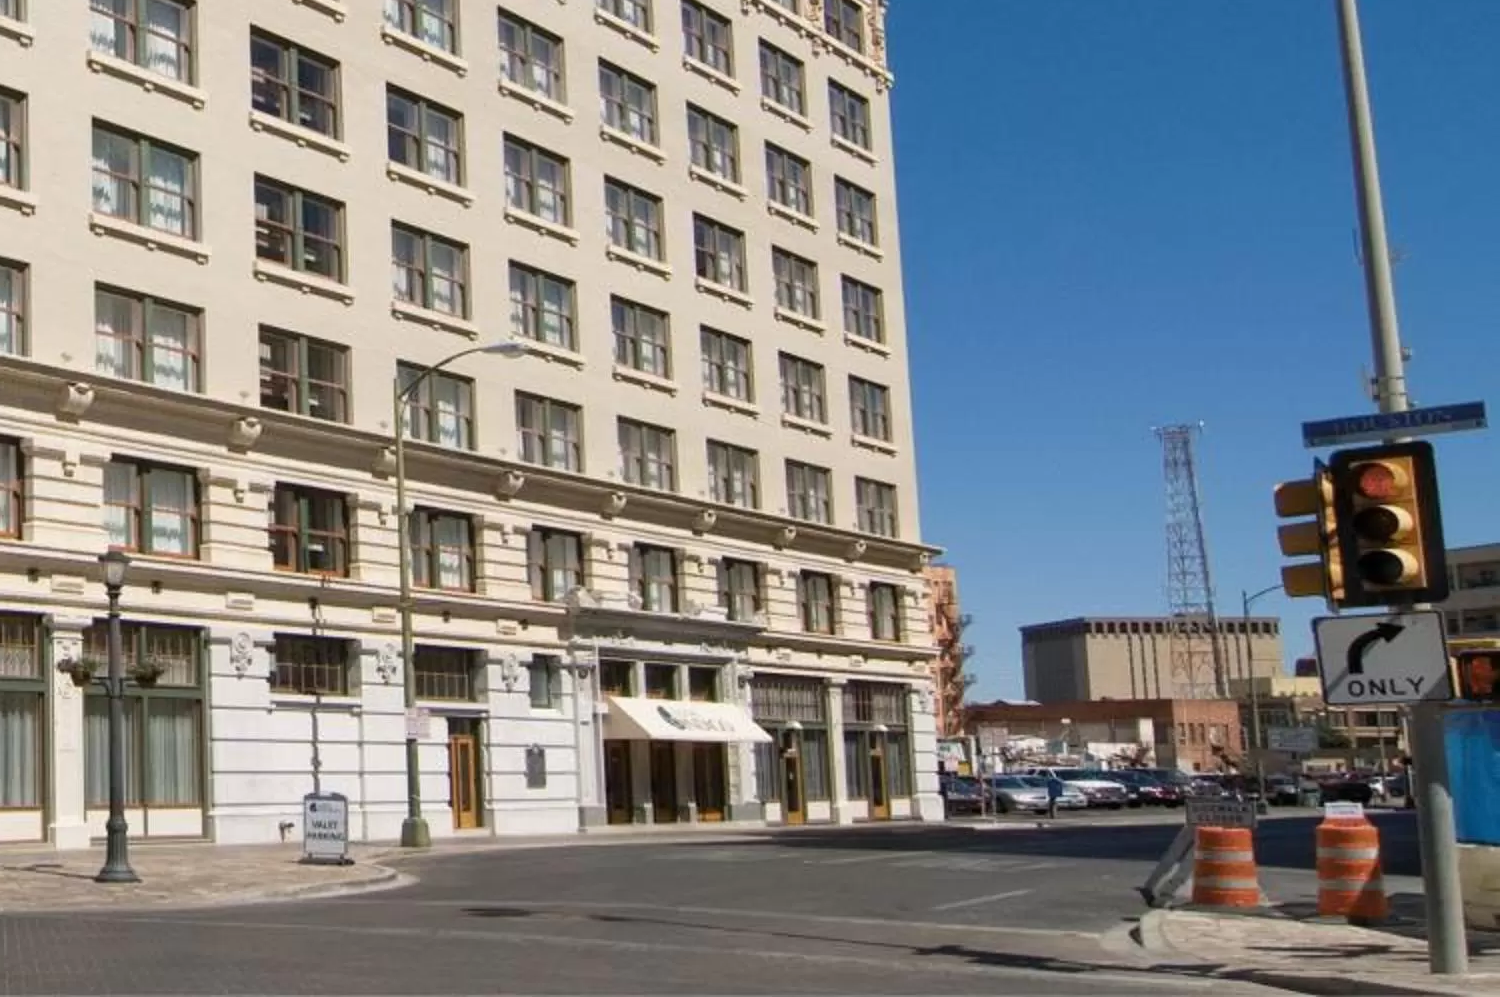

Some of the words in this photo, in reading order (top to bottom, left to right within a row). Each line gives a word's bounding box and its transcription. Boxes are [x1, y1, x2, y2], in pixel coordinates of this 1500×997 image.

[1347, 675, 1425, 698] ONLY
[311, 819, 339, 829] VALET
[306, 831, 346, 841] PARKING
